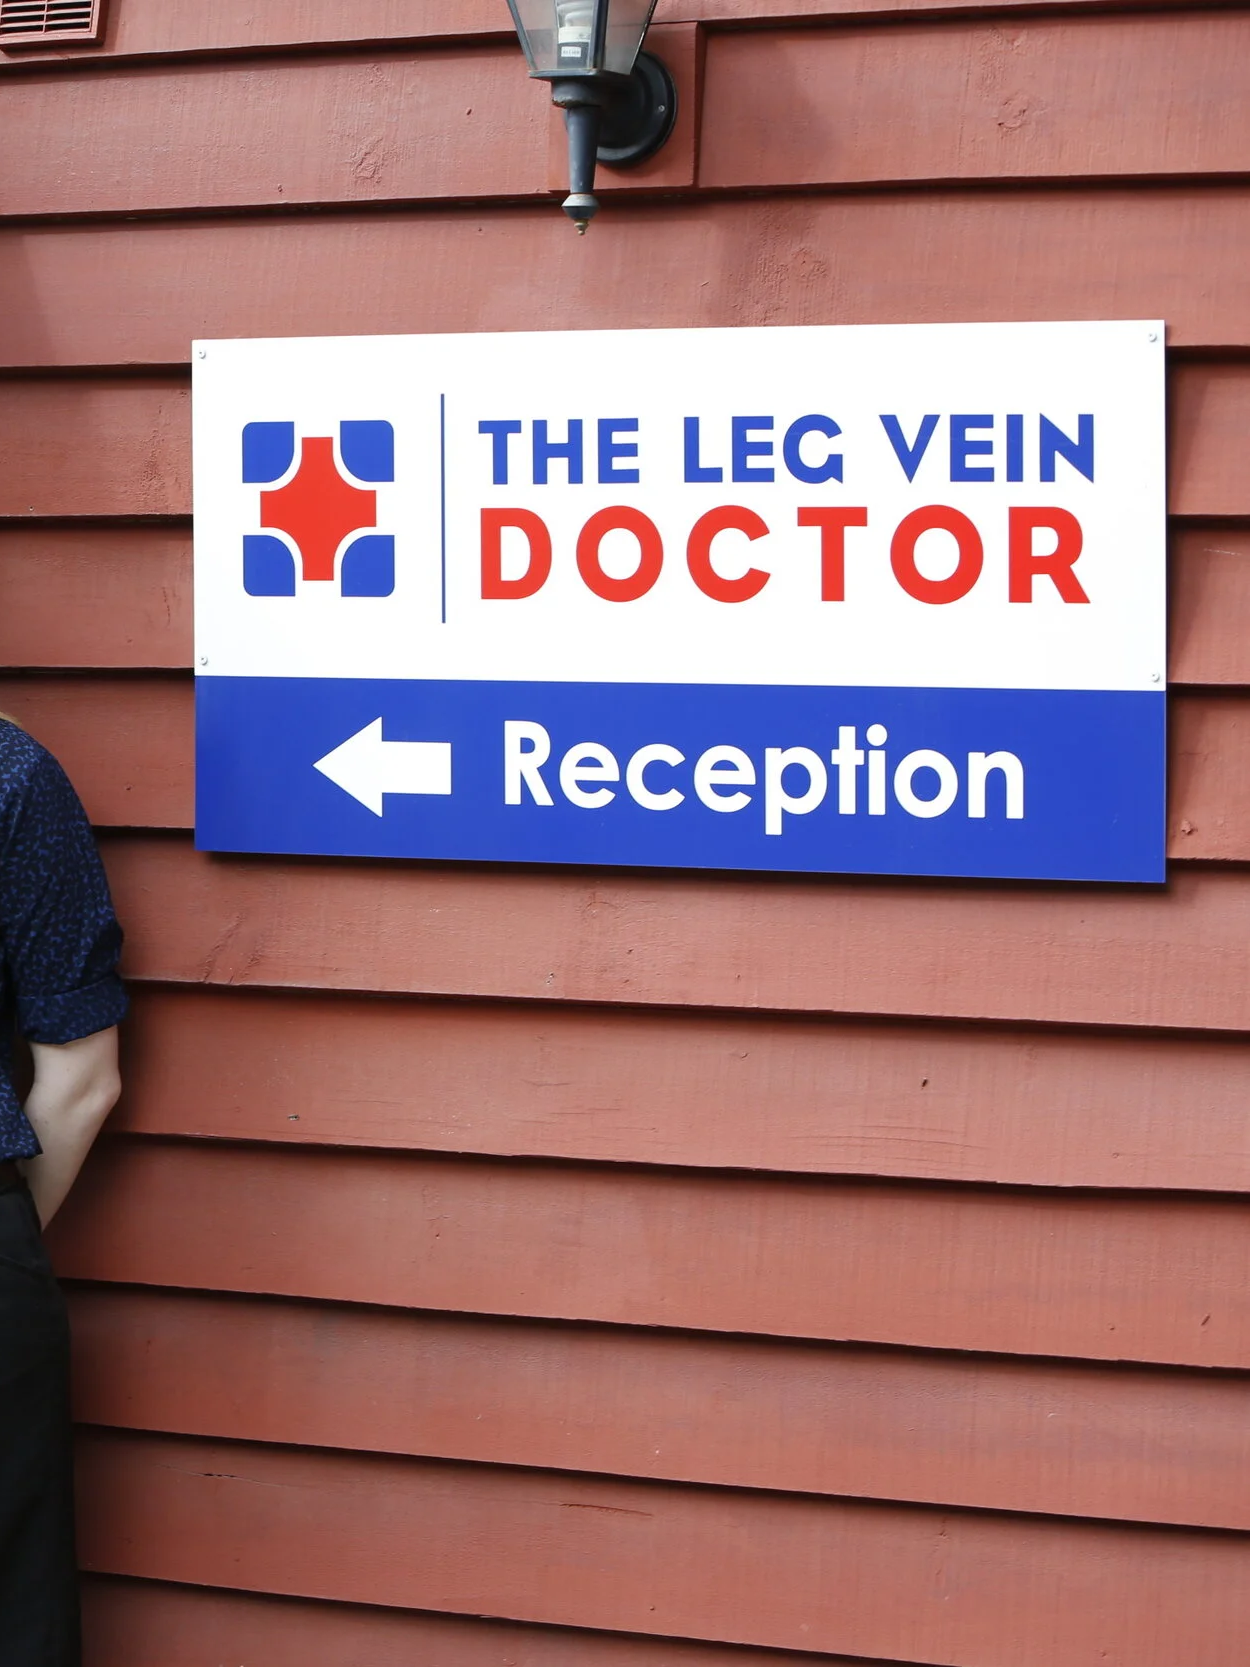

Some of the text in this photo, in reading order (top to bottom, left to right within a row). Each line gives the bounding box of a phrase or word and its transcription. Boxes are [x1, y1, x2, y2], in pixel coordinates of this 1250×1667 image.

[478, 413, 1096, 486] THE LEG VEIN
[480, 504, 1092, 605] DOCTOR
[504, 720, 1025, 837] Reception
